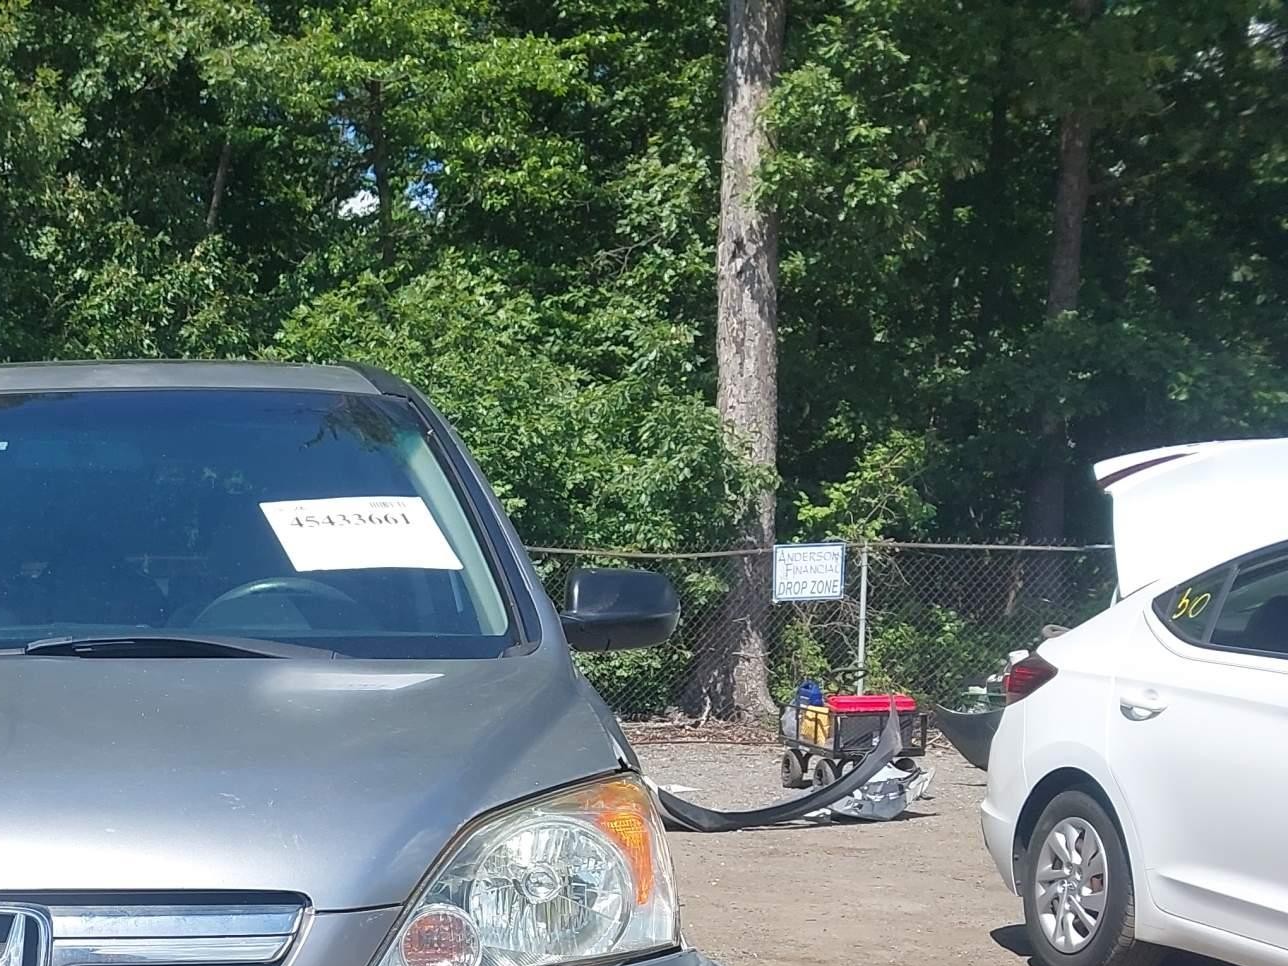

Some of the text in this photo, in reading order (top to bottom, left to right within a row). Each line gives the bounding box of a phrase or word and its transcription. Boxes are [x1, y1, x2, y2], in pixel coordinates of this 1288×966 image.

[290, 512, 411, 528] 45433661
[778, 550, 840, 562] ANDERSON
[777, 579, 839, 596] DROP ZONE
